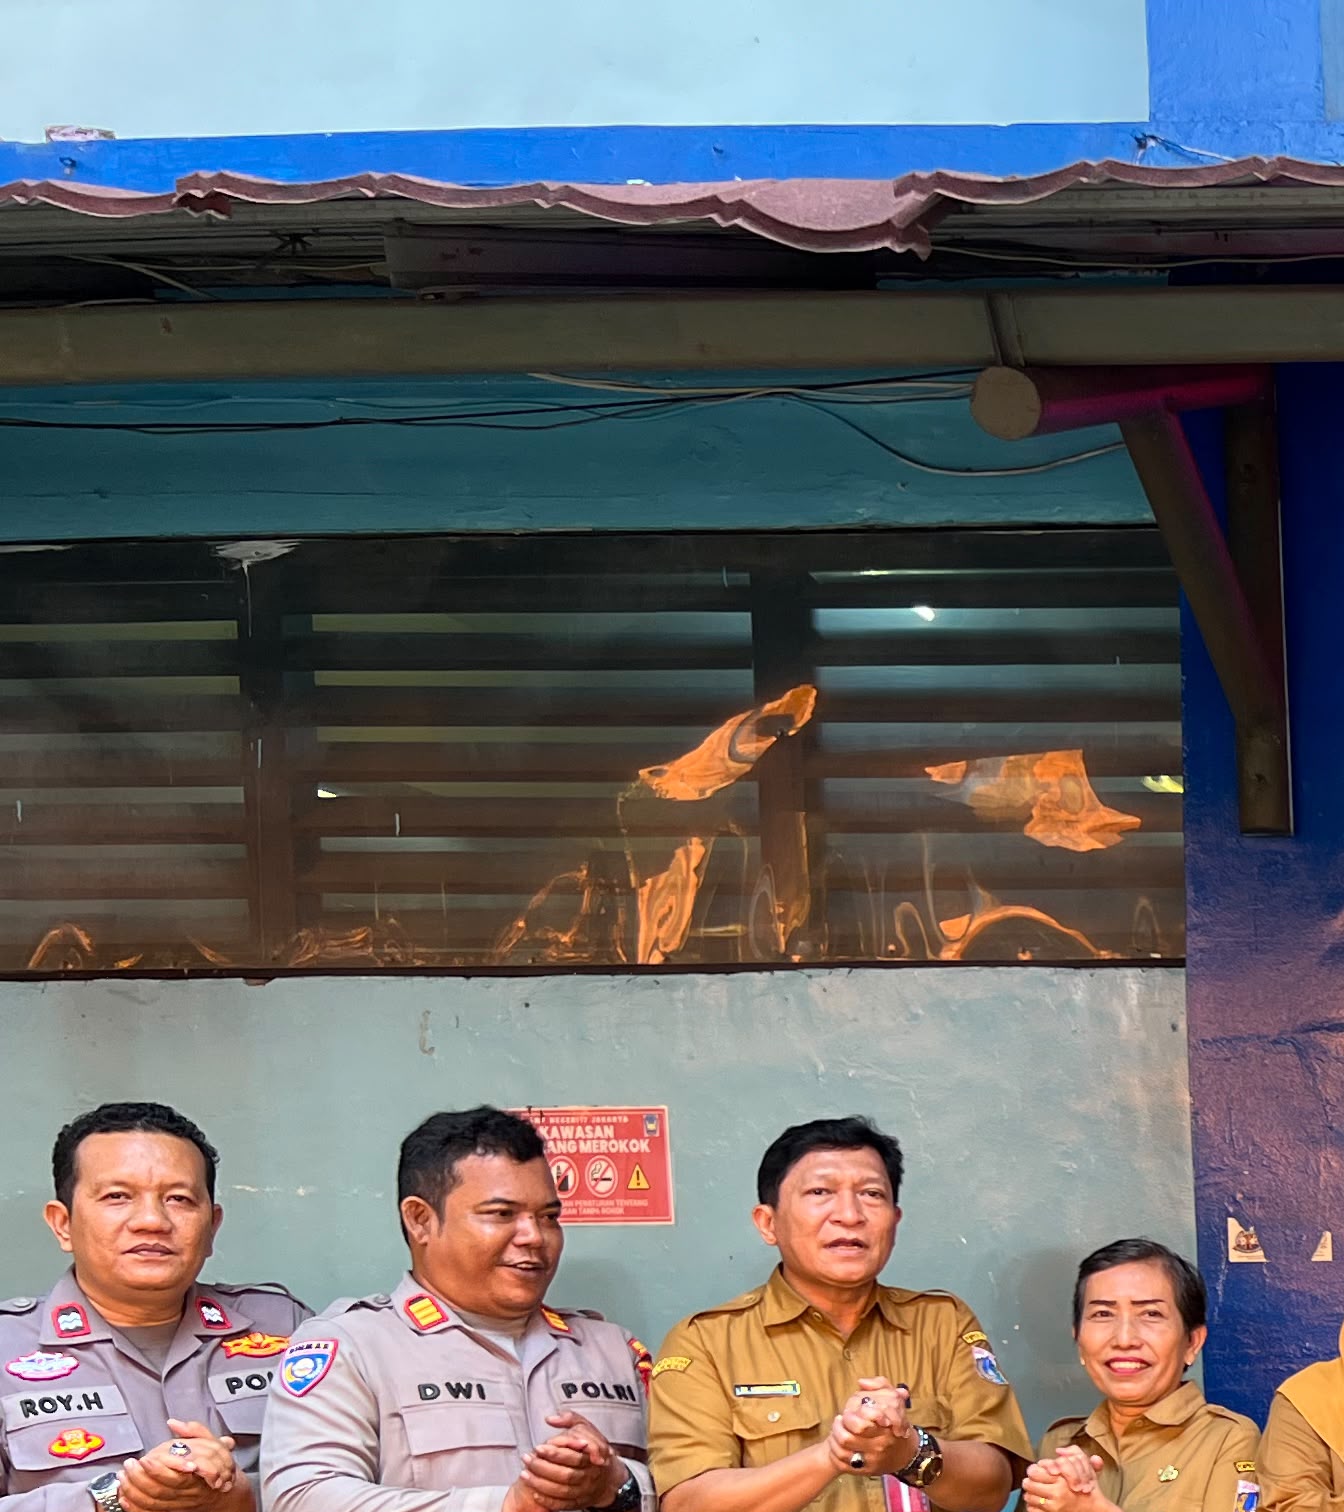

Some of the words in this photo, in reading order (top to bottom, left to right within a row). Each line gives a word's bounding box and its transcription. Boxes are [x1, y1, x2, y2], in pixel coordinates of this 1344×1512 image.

[579, 1139, 652, 1153] MEROKOK
[417, 1382, 486, 1401] DWI
[561, 1382, 636, 1402] POLRI
[20, 1392, 104, 1418] ROY.H
